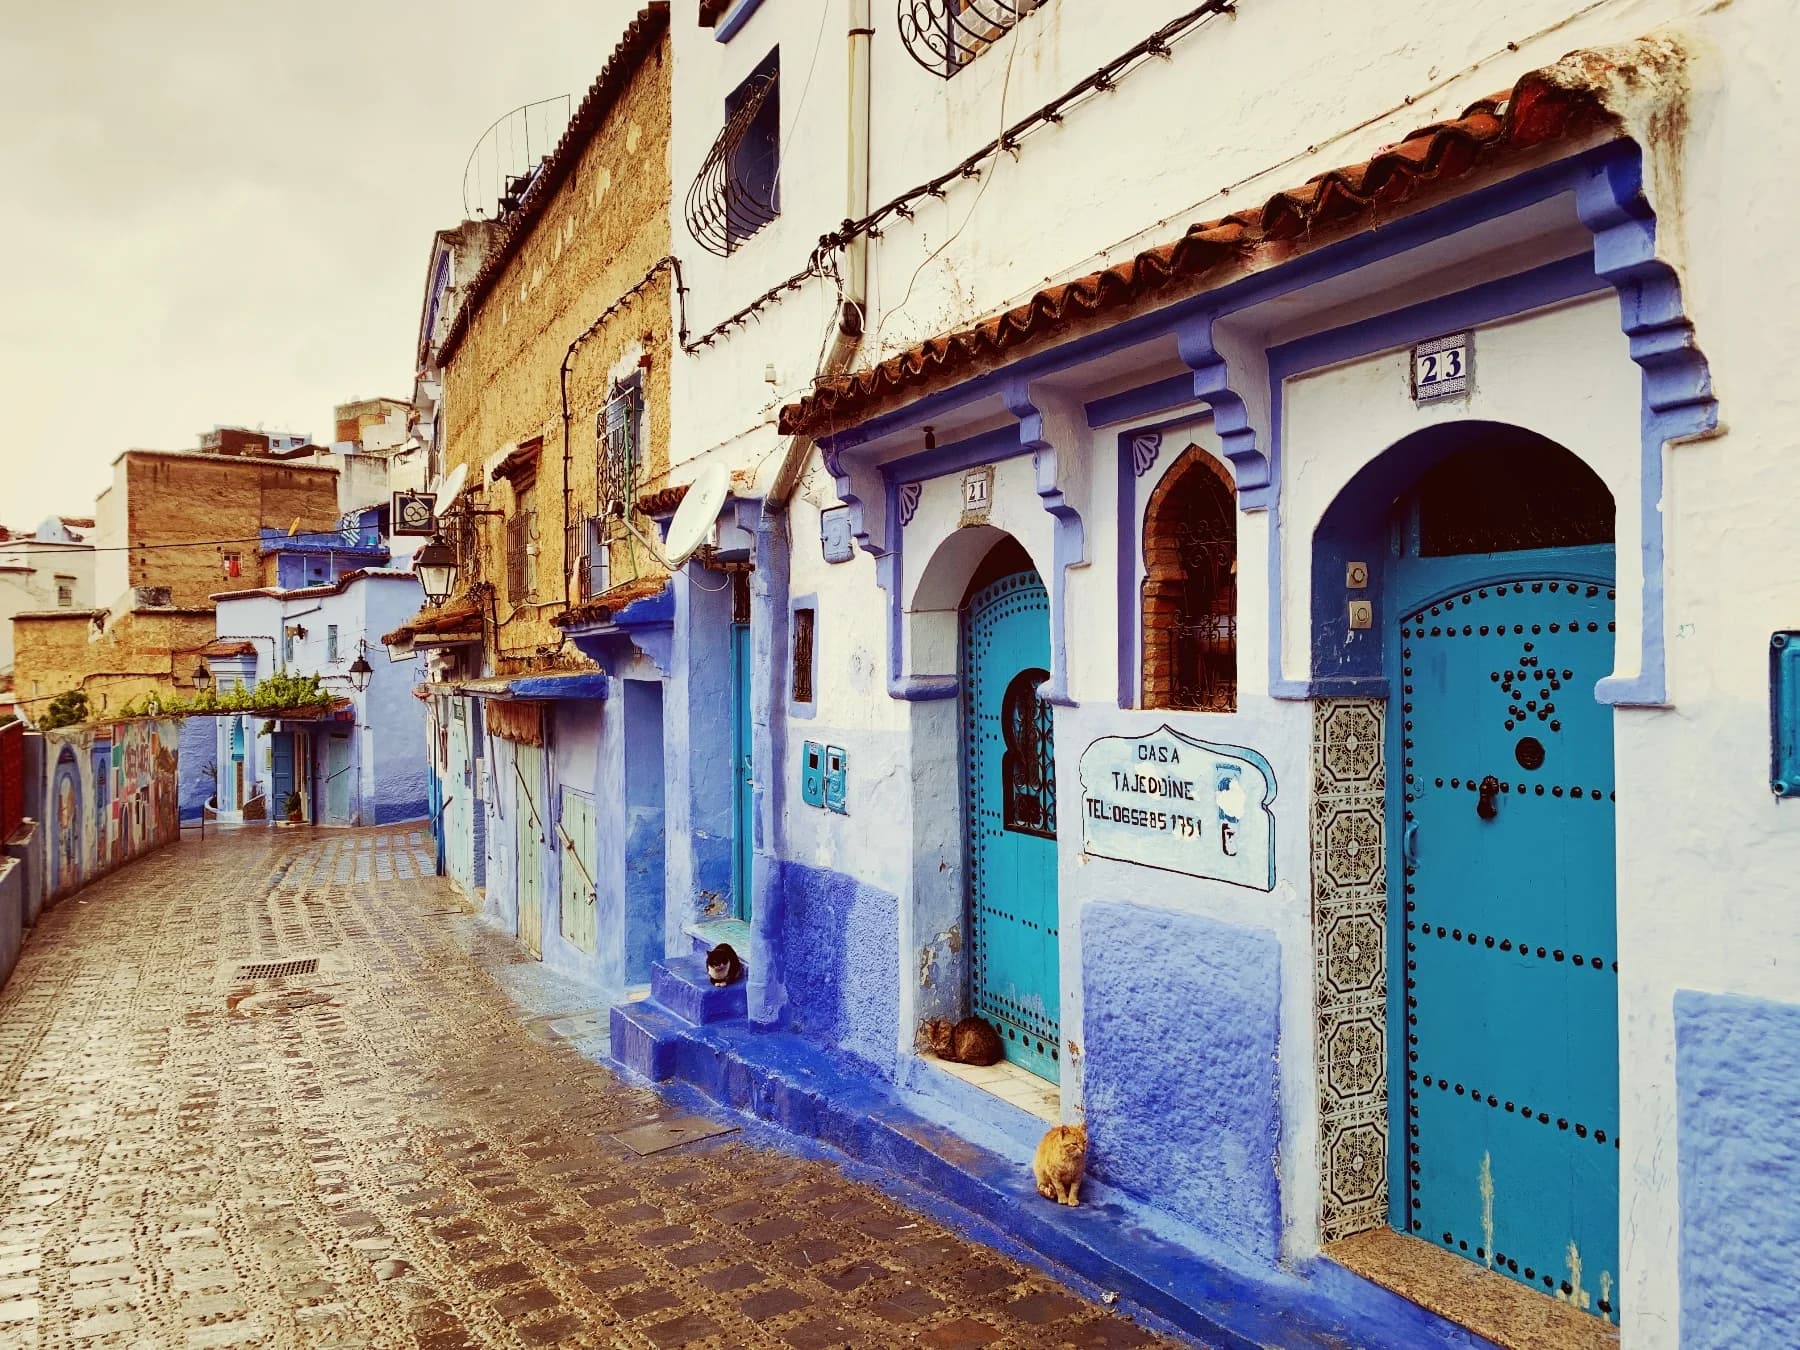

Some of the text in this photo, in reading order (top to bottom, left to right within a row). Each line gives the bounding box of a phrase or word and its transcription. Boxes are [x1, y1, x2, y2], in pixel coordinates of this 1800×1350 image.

[1422, 350, 1461, 383] 23
[968, 482, 985, 501] 21
[1138, 745, 1180, 764] CASA
